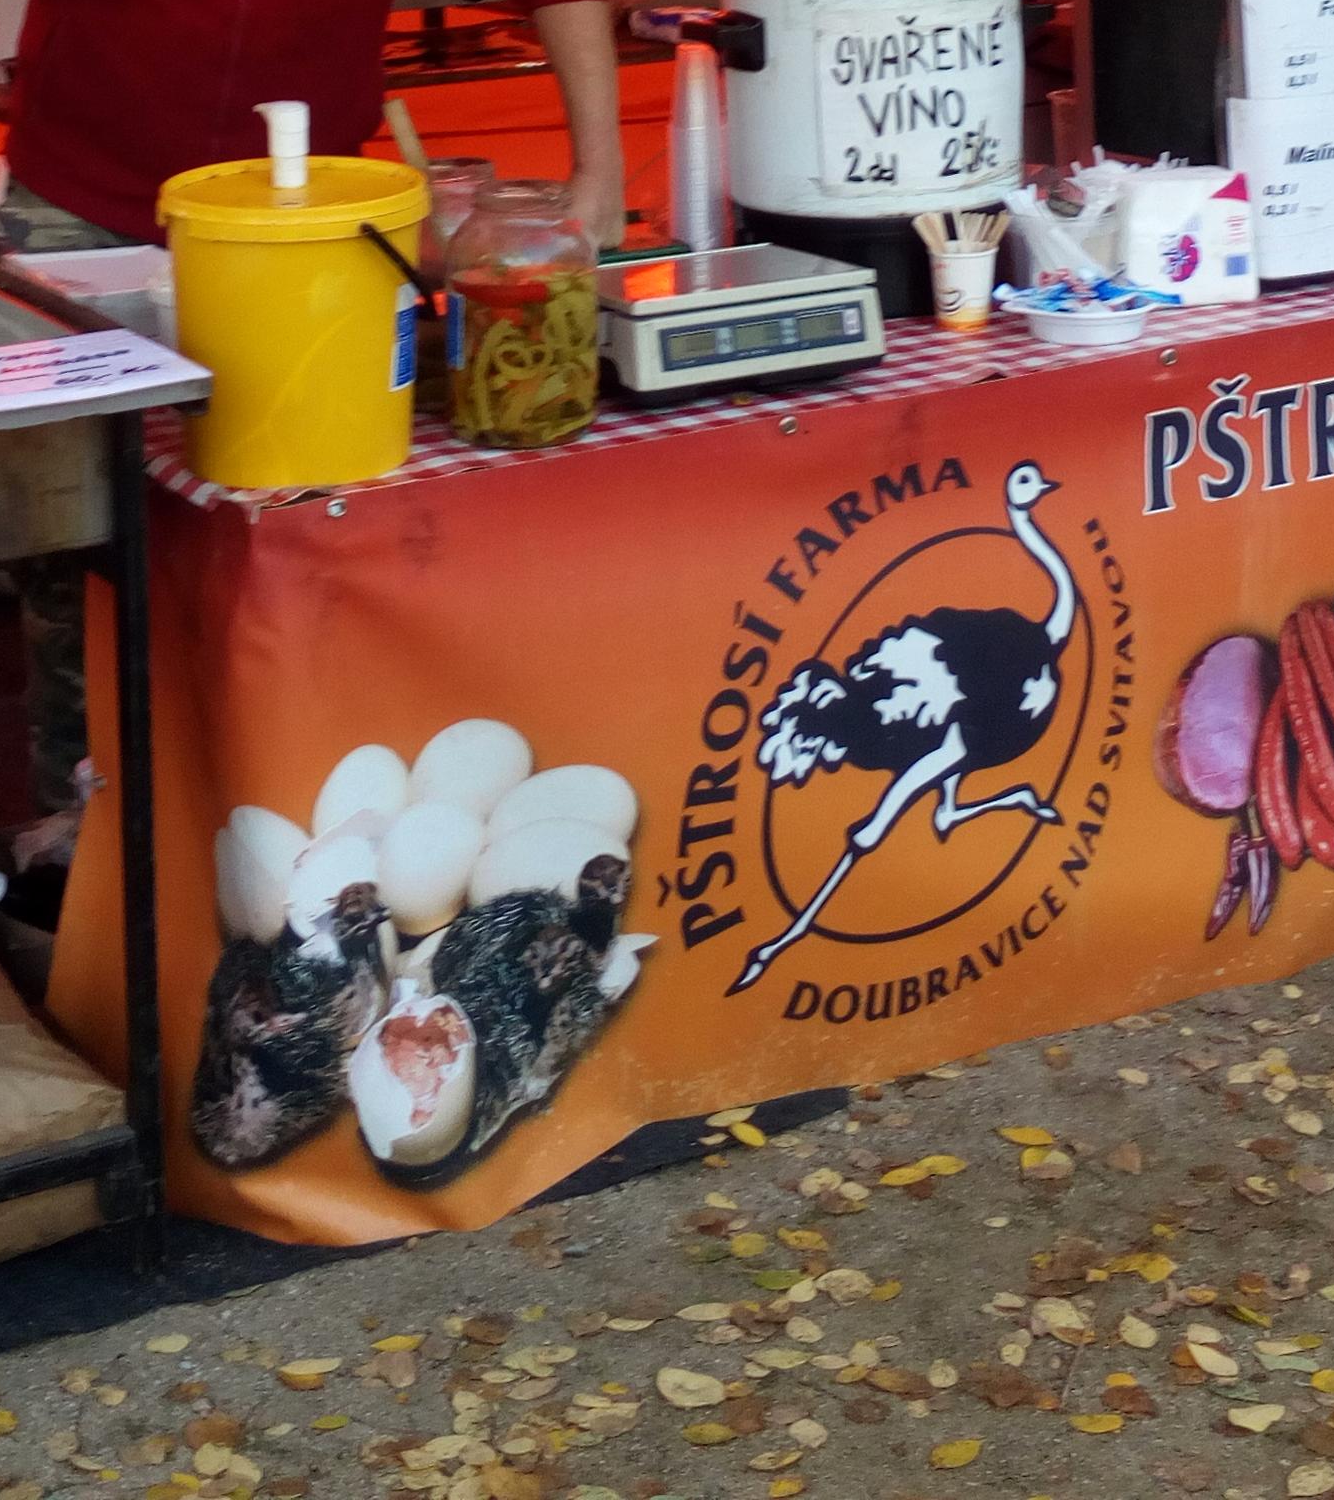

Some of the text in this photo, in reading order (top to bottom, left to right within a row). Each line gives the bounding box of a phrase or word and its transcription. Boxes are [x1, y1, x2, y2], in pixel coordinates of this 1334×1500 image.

[830, 5, 1007, 87] SVAŘENÉ
[858, 83, 968, 138] VÍNO
[119, 362, 162, 376] Kč
[655, 456, 973, 952] PŠTROSÍ FARMA
[782, 517, 1136, 1025] DOUBRAVICE NAD SVITAVOU
